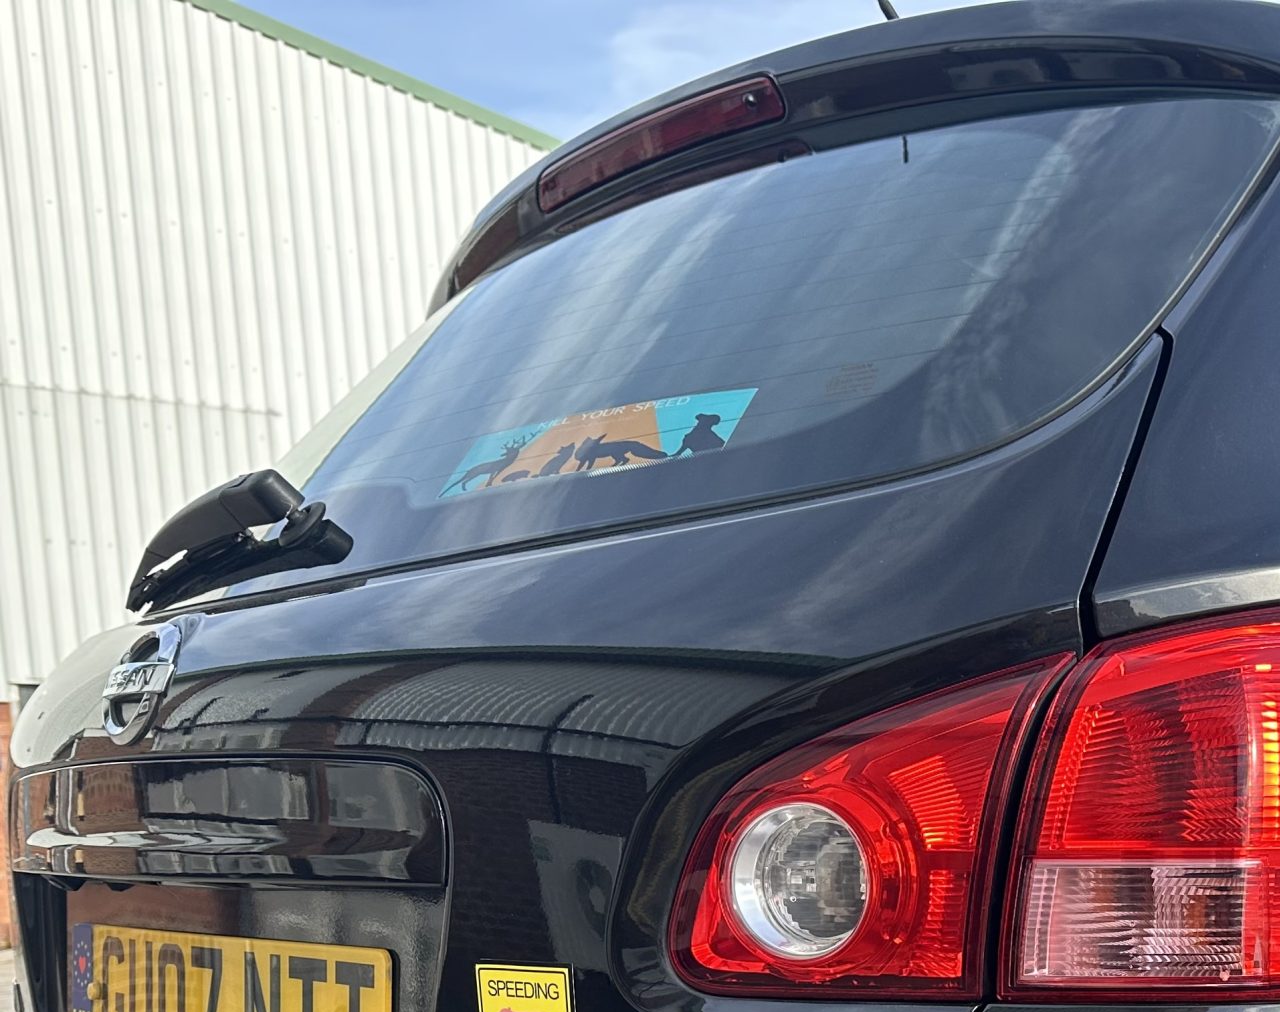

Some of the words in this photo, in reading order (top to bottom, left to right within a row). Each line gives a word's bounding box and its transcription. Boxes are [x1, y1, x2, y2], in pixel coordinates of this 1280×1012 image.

[536, 416, 570, 430] KILL
[580, 405, 627, 421] YOUR
[632, 397, 691, 413] SPEED
[488, 980, 560, 1000] SPEEDING
